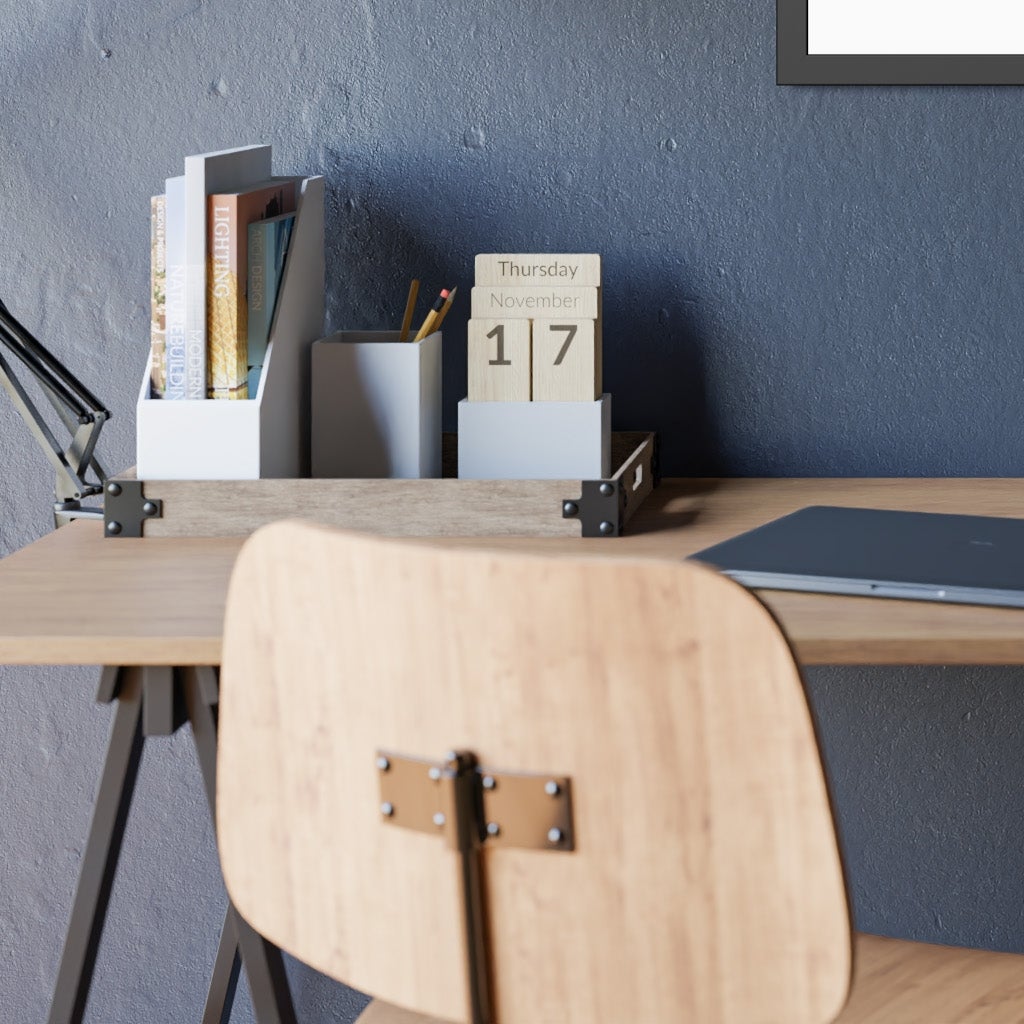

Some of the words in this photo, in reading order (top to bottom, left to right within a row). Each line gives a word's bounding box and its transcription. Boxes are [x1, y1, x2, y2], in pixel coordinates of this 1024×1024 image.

[214, 206, 230, 298] LIGHTING
[498, 261, 578, 280] Thursday
[252, 265, 263, 311] DESIGN
[490, 293, 580, 308] November
[189, 329, 203, 397] MODERN
